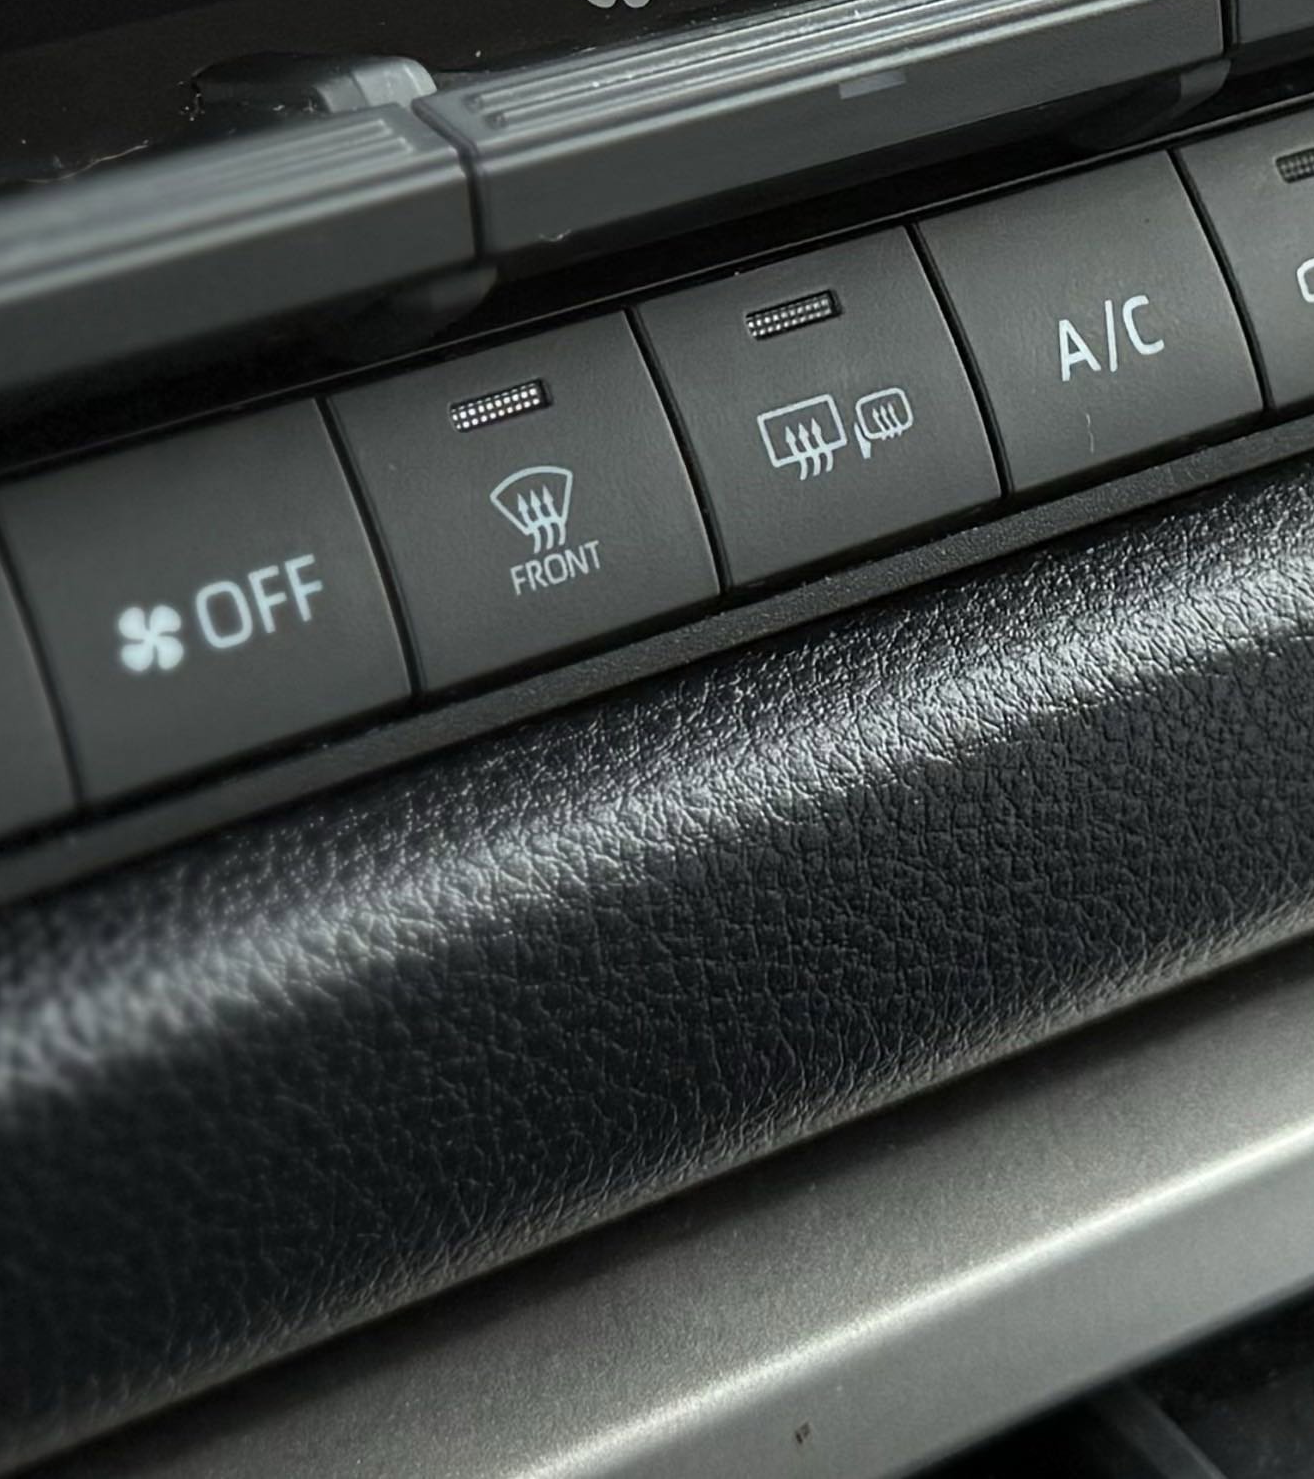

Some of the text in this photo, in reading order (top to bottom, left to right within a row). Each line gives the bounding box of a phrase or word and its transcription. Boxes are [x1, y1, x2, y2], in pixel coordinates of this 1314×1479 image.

[1056, 294, 1165, 382] A/C
[195, 553, 324, 649] OFF
[509, 540, 600, 596] FRONT
